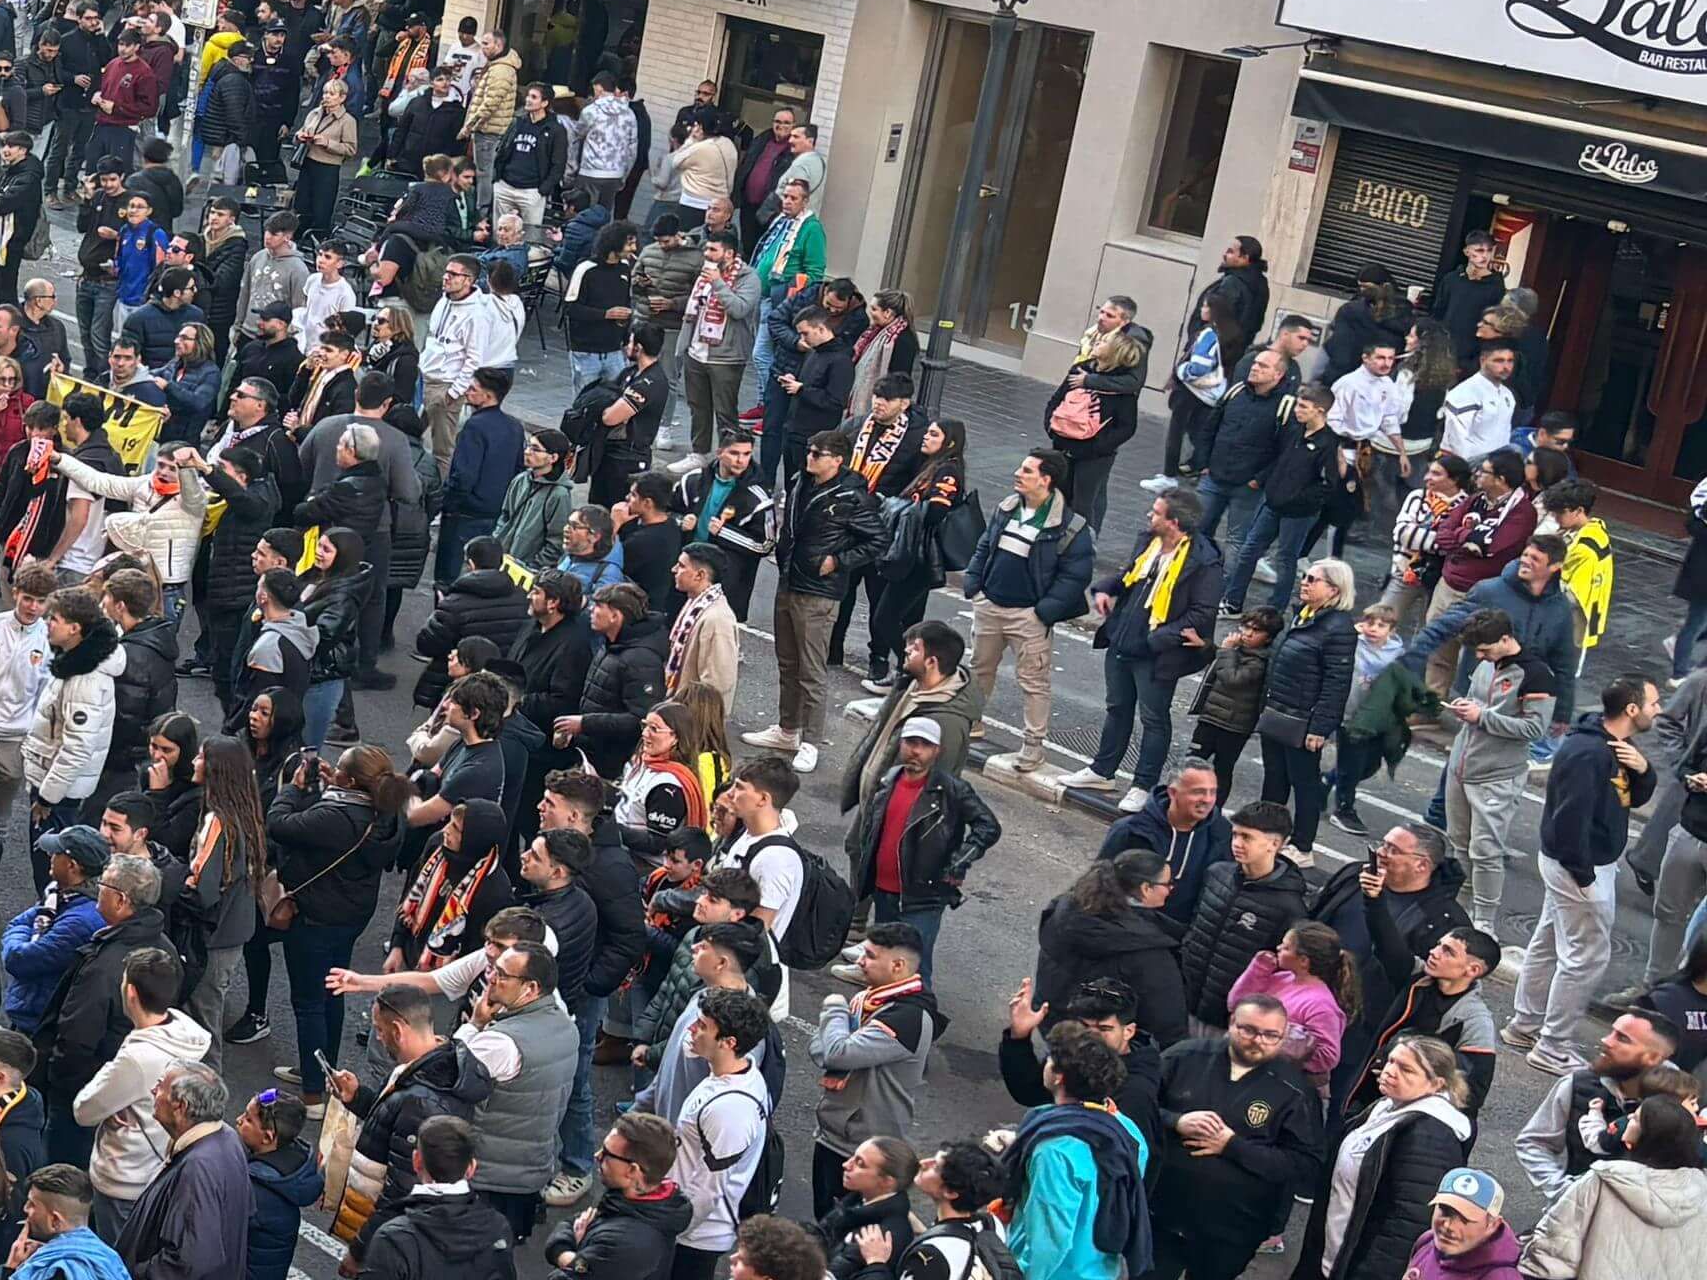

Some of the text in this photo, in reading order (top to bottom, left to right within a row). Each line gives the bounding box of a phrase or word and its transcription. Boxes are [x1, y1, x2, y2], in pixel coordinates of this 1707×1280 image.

[1638, 50, 1664, 68] BAR
[1603, 142, 1659, 176] Palco
[1354, 179, 1430, 228] palco
[1009, 302, 1038, 333] 15
